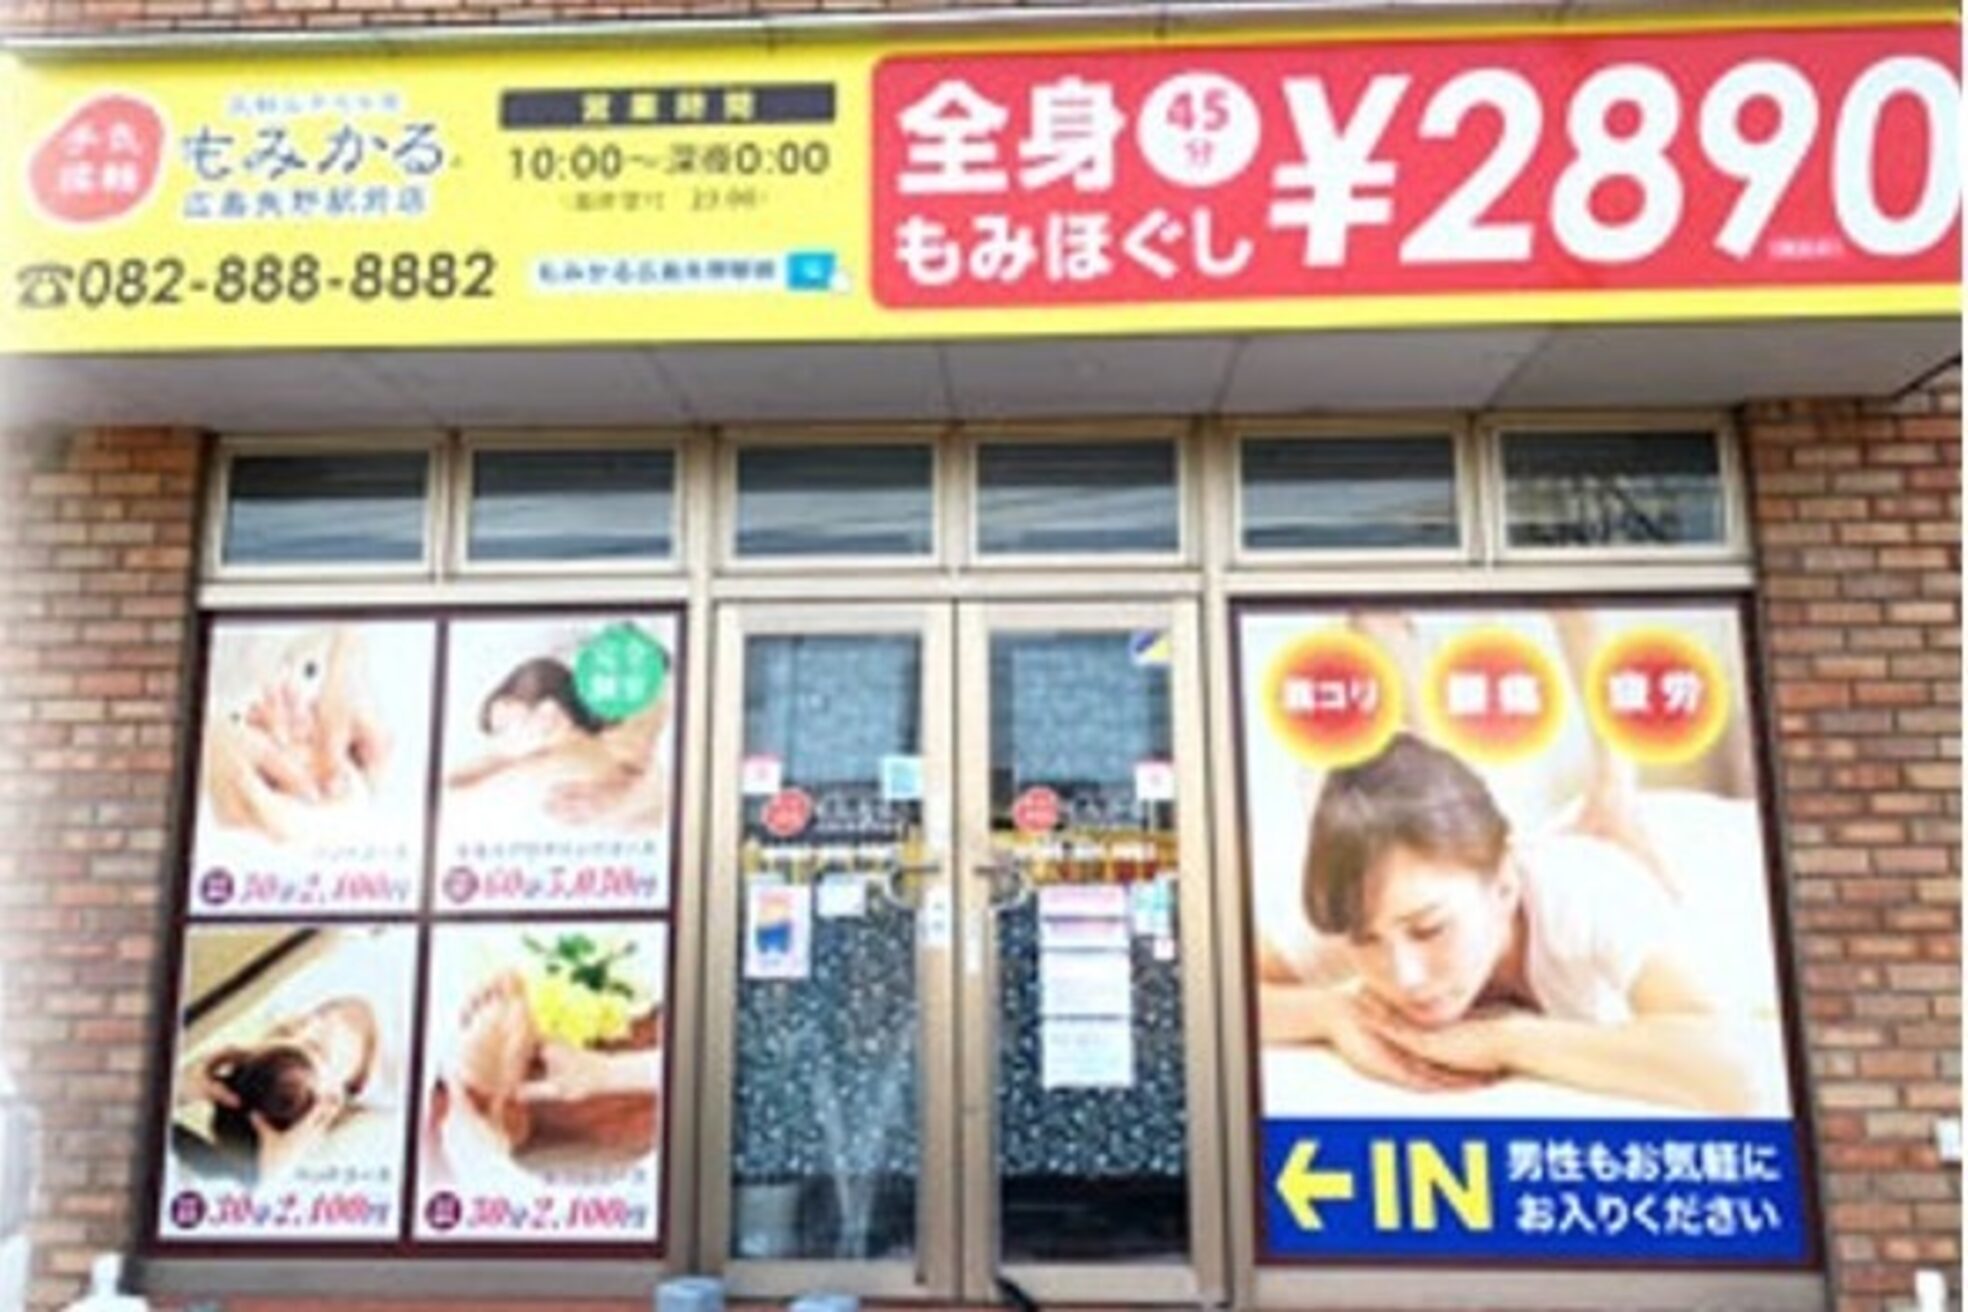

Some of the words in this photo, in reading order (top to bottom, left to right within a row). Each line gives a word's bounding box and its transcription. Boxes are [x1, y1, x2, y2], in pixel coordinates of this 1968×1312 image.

[898, 77, 1126, 195] 全身
[1164, 89, 1231, 133] 45
[181, 123, 448, 183] もみかる
[1184, 138, 1216, 167] 分
[1267, 55, 1962, 267] ¥2890
[895, 206, 1254, 286] もみほぐし
[78, 249, 498, 309] 082-888-8882
[1370, 1138, 1494, 1232] IN
[1506, 1138, 1782, 1184] 男性もお気軽に
[1515, 1192, 1782, 1237] お入りください
